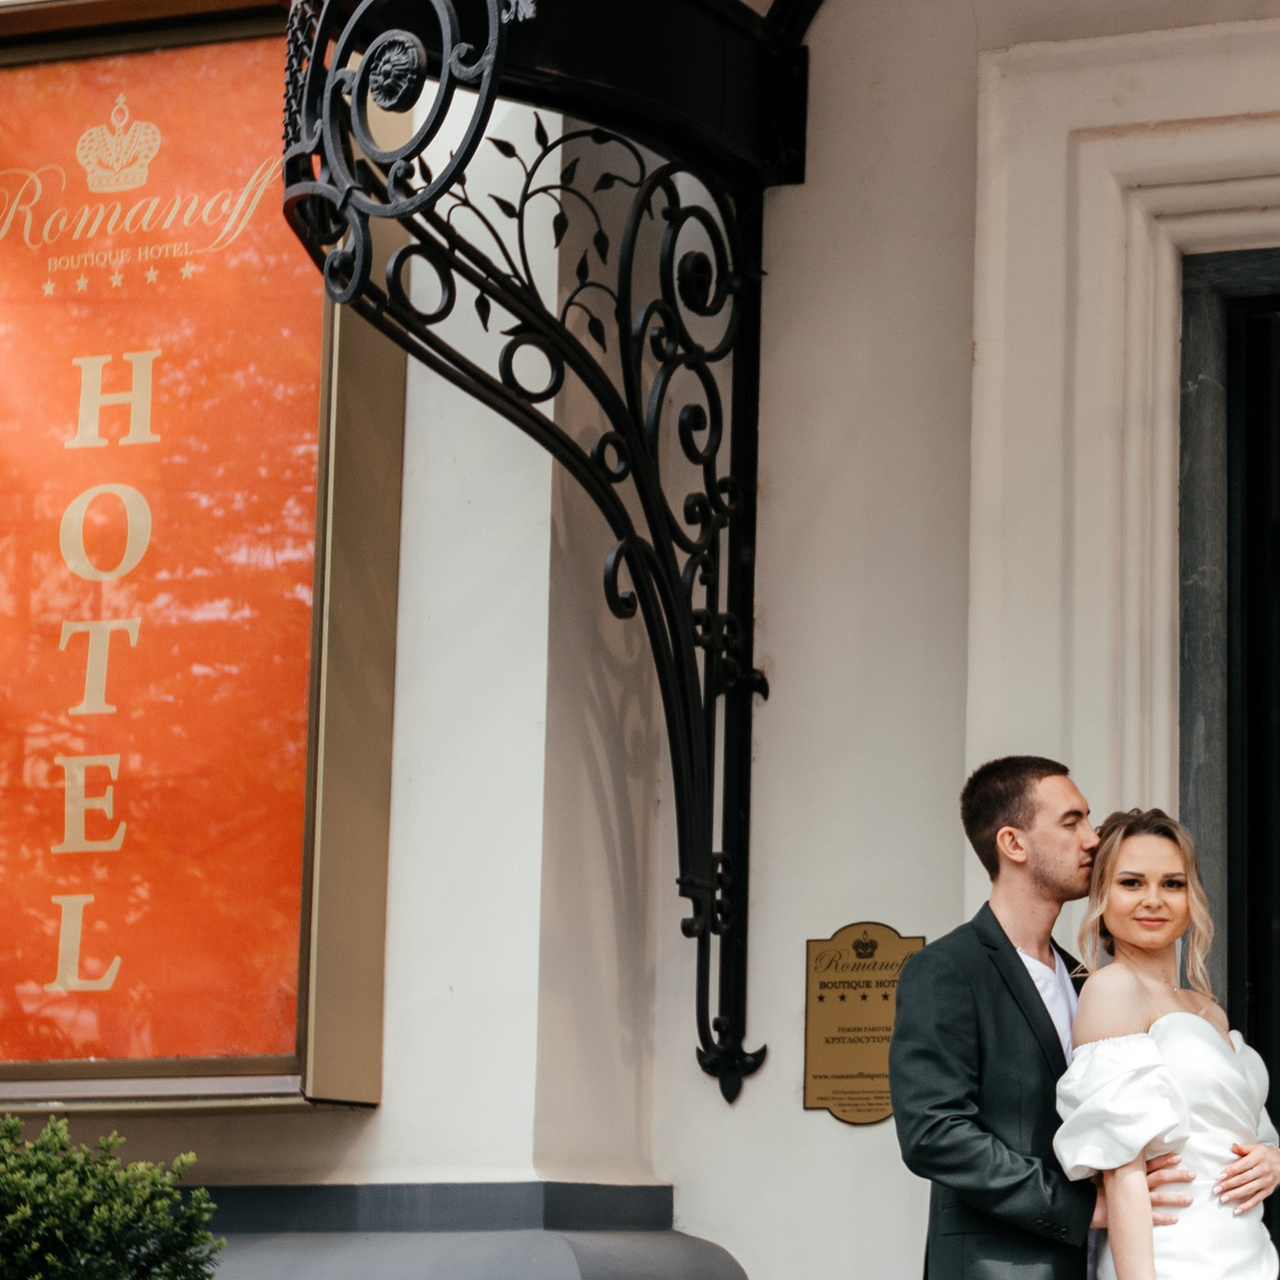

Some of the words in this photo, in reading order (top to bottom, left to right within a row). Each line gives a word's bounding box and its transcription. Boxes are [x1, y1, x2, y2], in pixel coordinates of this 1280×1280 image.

[0, 156, 284, 254] Romanoff
[48, 248, 131, 272] BOUTIQUE
[138, 242, 194, 262] HOTEL
[44, 350, 162, 992] HOTEL
[814, 949, 914, 978] Romanof
[819, 980, 872, 991] BOUTIQUE
[875, 980, 899, 988] HOT
[824, 1035, 893, 1045] КРУГЛОСУТОЧ
[812, 1071, 890, 1080] www.romanoffimperia
